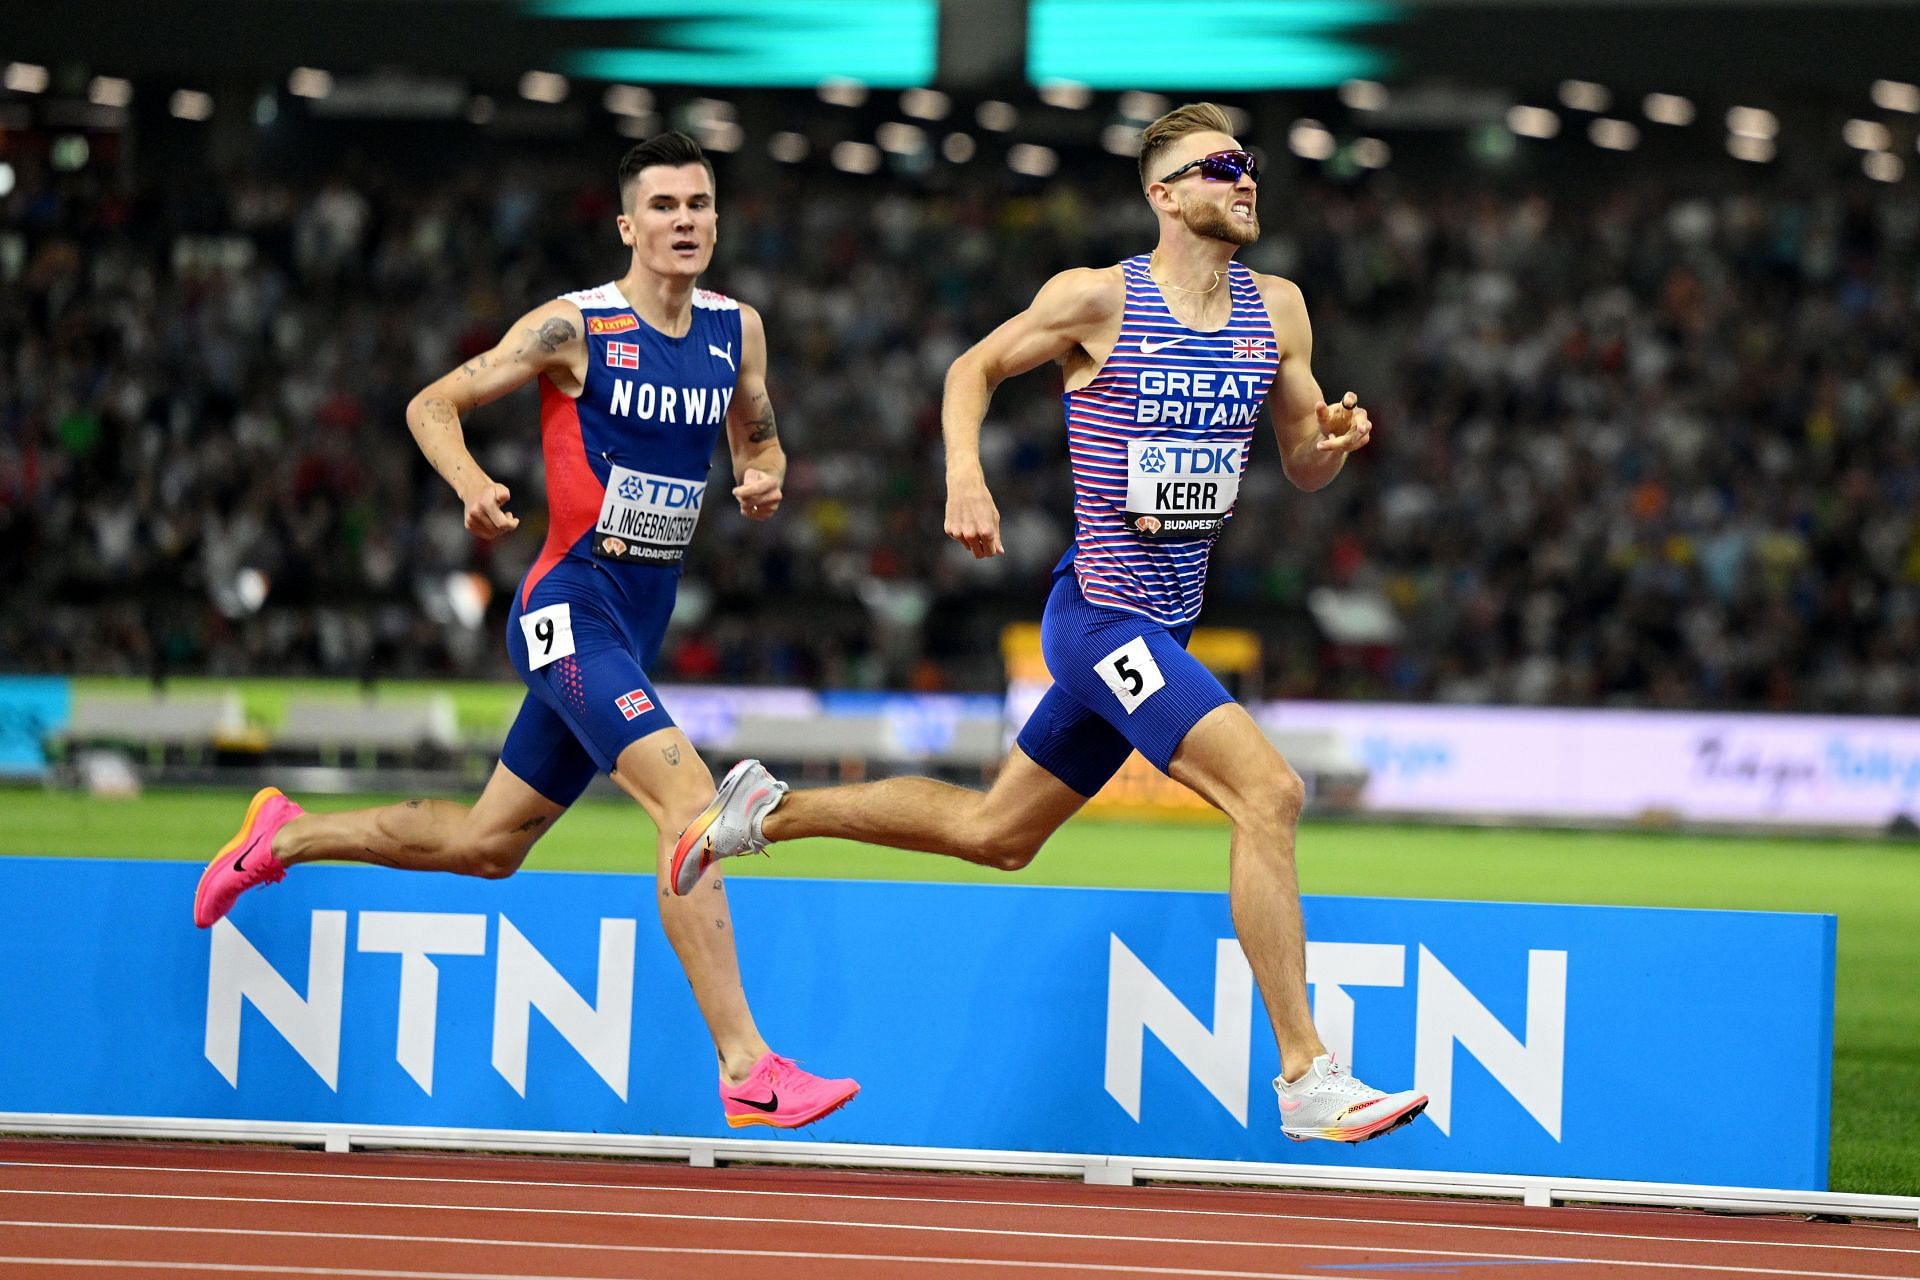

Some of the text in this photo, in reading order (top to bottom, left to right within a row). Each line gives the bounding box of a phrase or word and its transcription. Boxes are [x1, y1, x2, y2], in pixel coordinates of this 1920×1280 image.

[604, 317, 635, 330] EXTRA
[1139, 370, 1261, 399] GREAT
[609, 379, 734, 425] NORWAY
[1136, 399, 1257, 426] BRITAIN
[1165, 447, 1237, 474] TDK
[646, 479, 706, 511] TDK
[1156, 482, 1218, 510] KERR
[602, 505, 614, 531] J.
[1164, 519, 1217, 530] BUDAPEST
[629, 545, 675, 560] BUDAPEST
[535, 616, 554, 655] 9
[1113, 655, 1144, 697] 5
[204, 909, 636, 1103] NTN
[1104, 931, 1568, 1144] NTN
